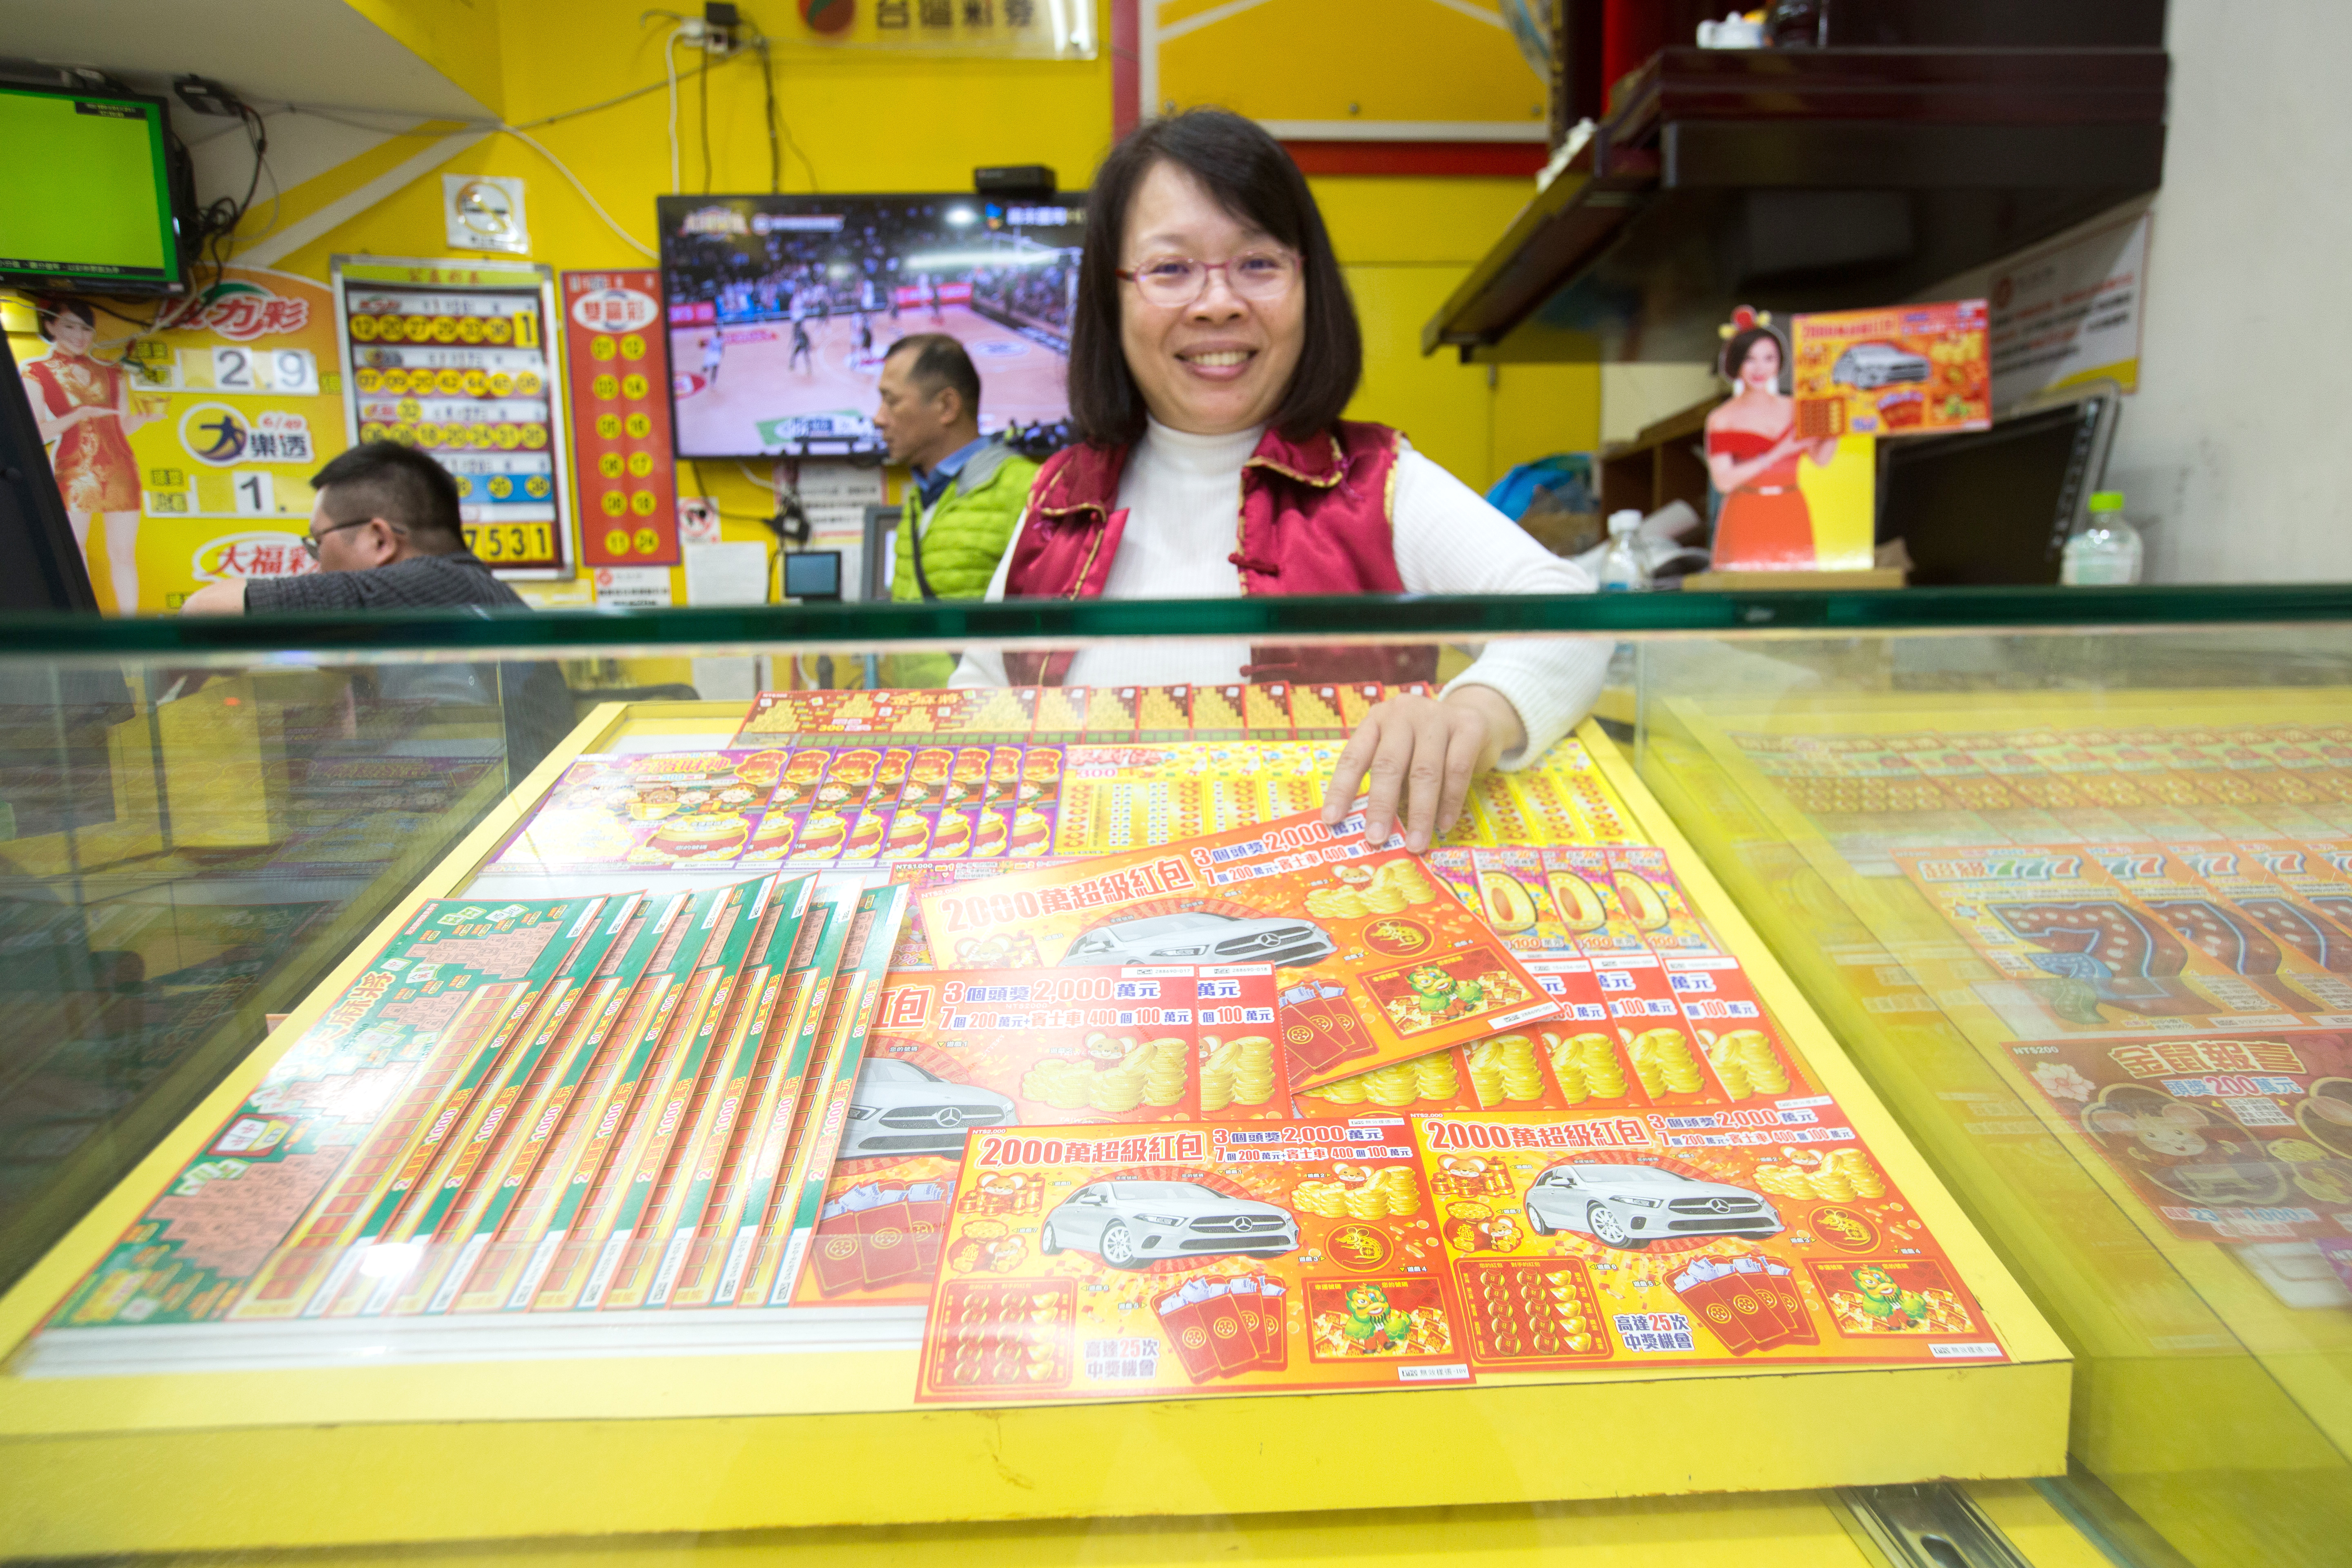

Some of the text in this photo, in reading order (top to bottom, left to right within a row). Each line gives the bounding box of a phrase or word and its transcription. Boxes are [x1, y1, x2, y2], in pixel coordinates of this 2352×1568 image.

[921, 887, 960, 898] NT$2,000
[944, 978, 1160, 1004] 3個頭獎2,000萬元
[1089, 1008, 1192, 1026] 400個100萬元
[1202, 1007, 1274, 1023] 個100萬元
[2013, 1046, 2059, 1055] NT$200
[2109, 1041, 2305, 1078] 金鼠報喜
[1650, 1108, 1817, 1129] 3個頭獎2,000萬元
[1213, 1125, 1383, 1144] 3個頭獎2,000萬元
[1772, 1128, 1854, 1142] 400個100萬元
[1215, 1146, 1412, 1162] 7個200萬元+賓士車 400個100萬元
[1615, 1314, 1688, 1332] 高達25次
[1624, 1333, 1693, 1350] 中獎機會
